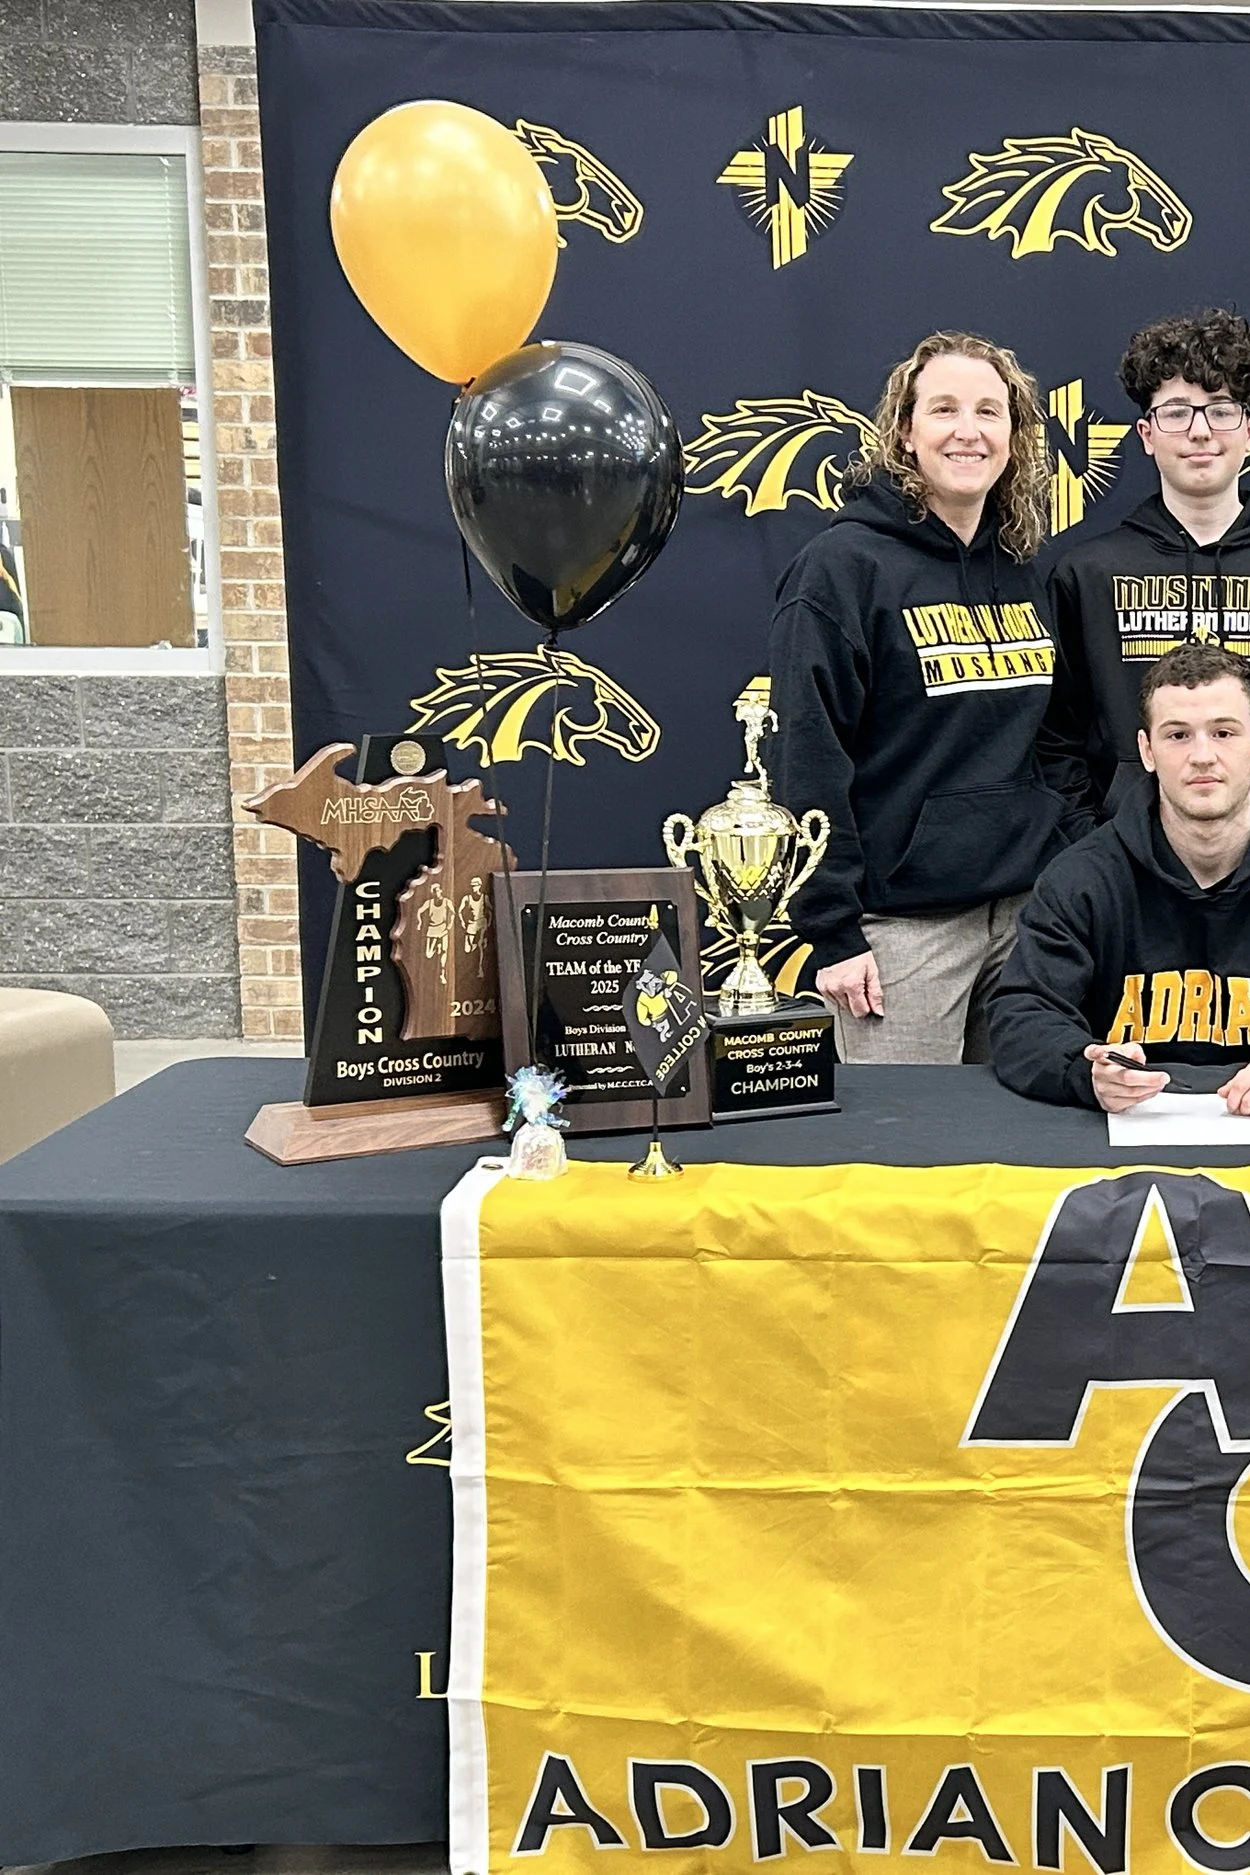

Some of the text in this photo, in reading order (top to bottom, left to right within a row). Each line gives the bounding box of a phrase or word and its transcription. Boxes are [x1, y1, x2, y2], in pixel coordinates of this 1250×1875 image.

[764, 144, 811, 210] N
[548, 914, 605, 929] Macomb
[556, 931, 649, 947] Cross Country
[355, 881, 383, 1045] CHAMPION
[545, 960, 588, 976] TEAM
[588, 959, 602, 975] of
[603, 959, 623, 975] the
[590, 979, 620, 995] 2025
[449, 1000, 497, 1018] 2024
[564, 1022, 627, 1037] Boys Division
[724, 1028, 824, 1047] MACOMB COUNTY
[554, 1041, 617, 1058] LUTHERAN
[727, 1042, 821, 1061] CROSS COUNTRY
[336, 1050, 485, 1081] Boys Cross Country
[746, 1059, 803, 1075] Boy's 2-3-4
[383, 1073, 443, 1088] DIVISION 2
[730, 1073, 819, 1095] CHAMPION
[509, 1748, 1134, 1875] ADRIAN
